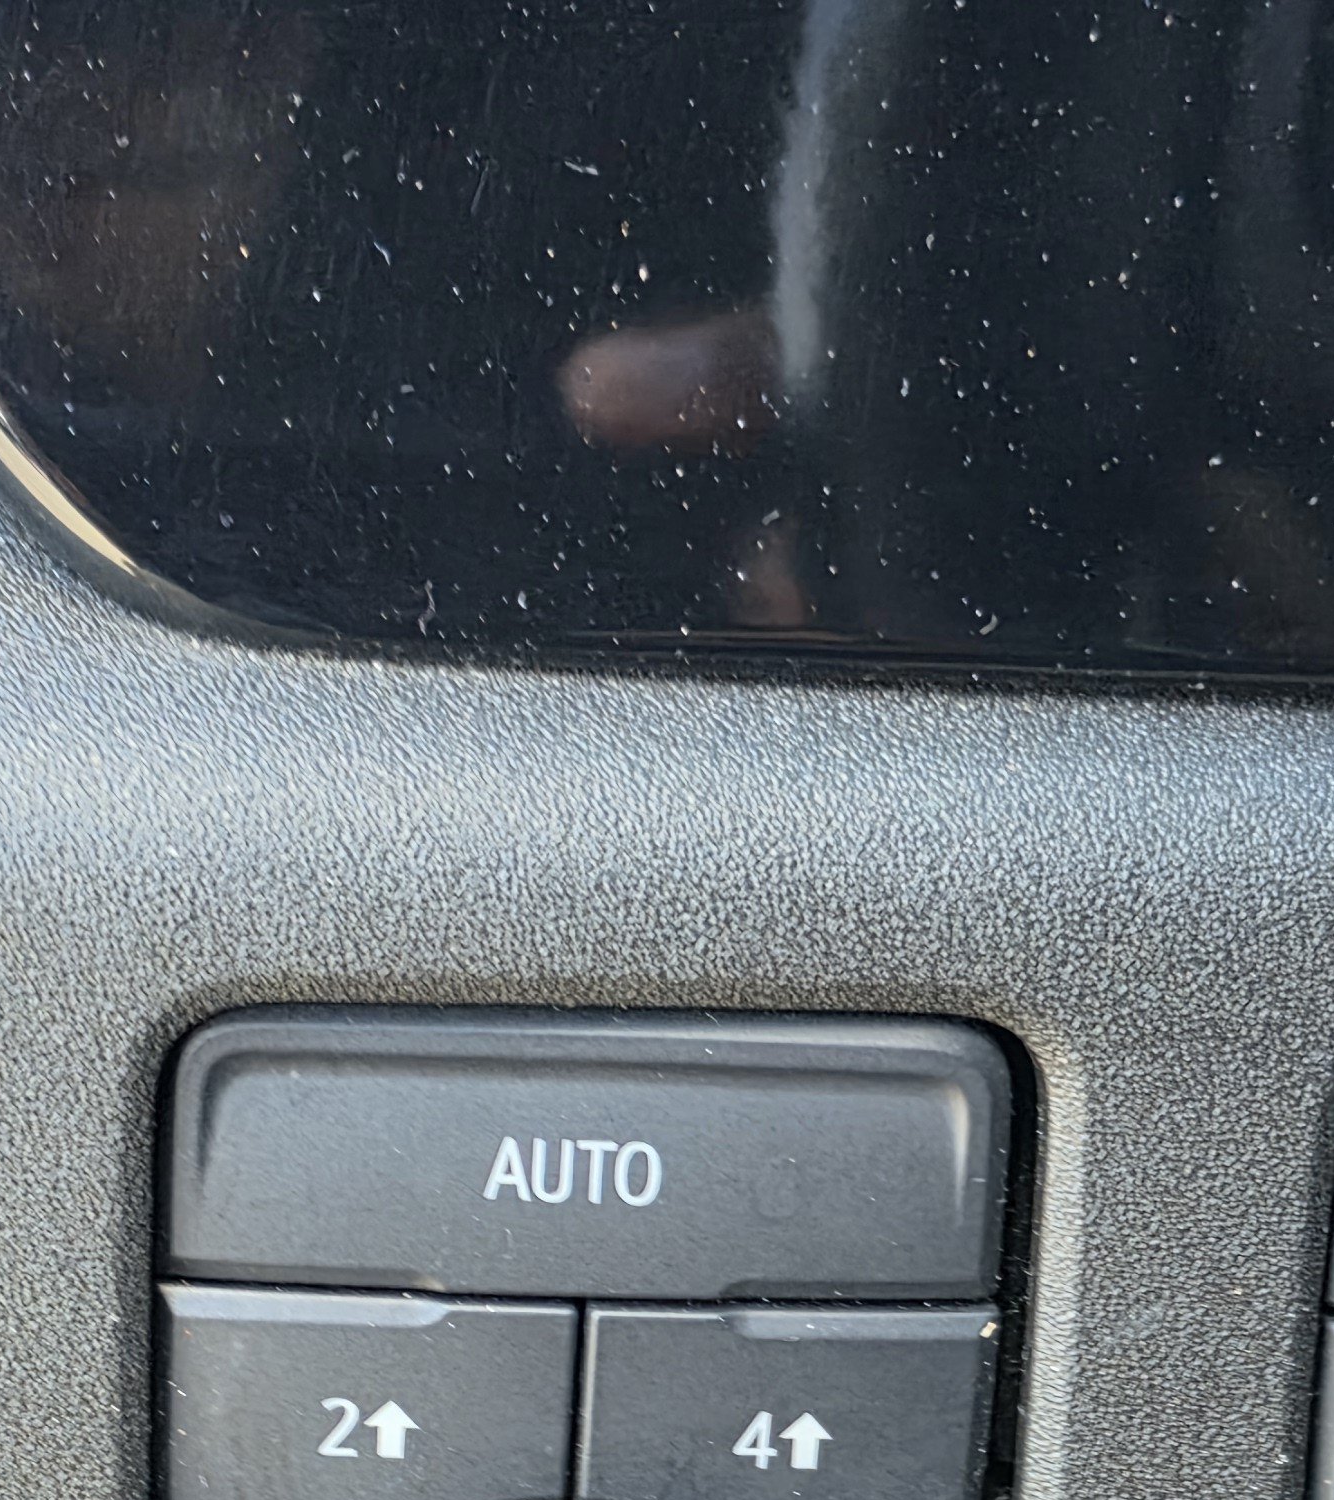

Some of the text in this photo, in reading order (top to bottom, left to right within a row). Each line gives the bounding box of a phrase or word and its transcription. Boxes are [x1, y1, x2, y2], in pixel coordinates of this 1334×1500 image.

[483, 1136, 663, 1207] AUTO
[317, 1396, 361, 1459] 2
[731, 1409, 779, 1471] 4
